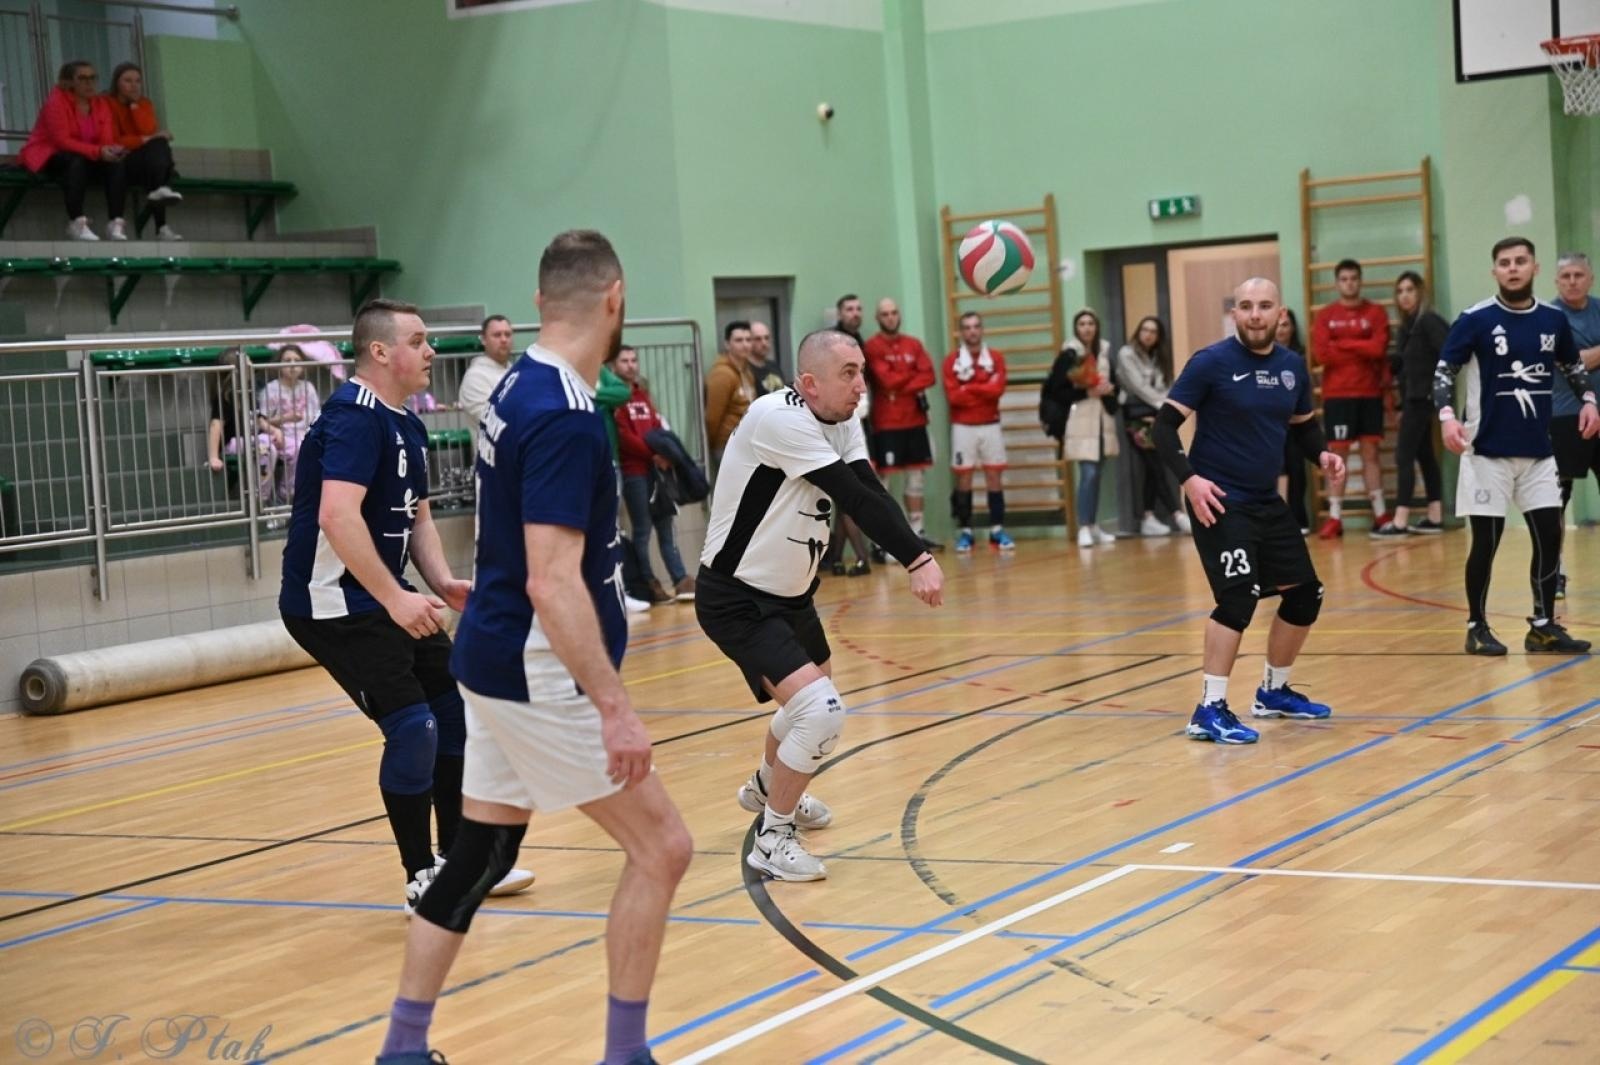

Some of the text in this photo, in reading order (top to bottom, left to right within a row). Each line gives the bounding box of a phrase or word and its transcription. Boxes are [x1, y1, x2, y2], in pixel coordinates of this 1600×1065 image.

[1495, 335, 1508, 355] 3
[398, 449, 407, 478] 6
[1220, 549, 1250, 578] 23
